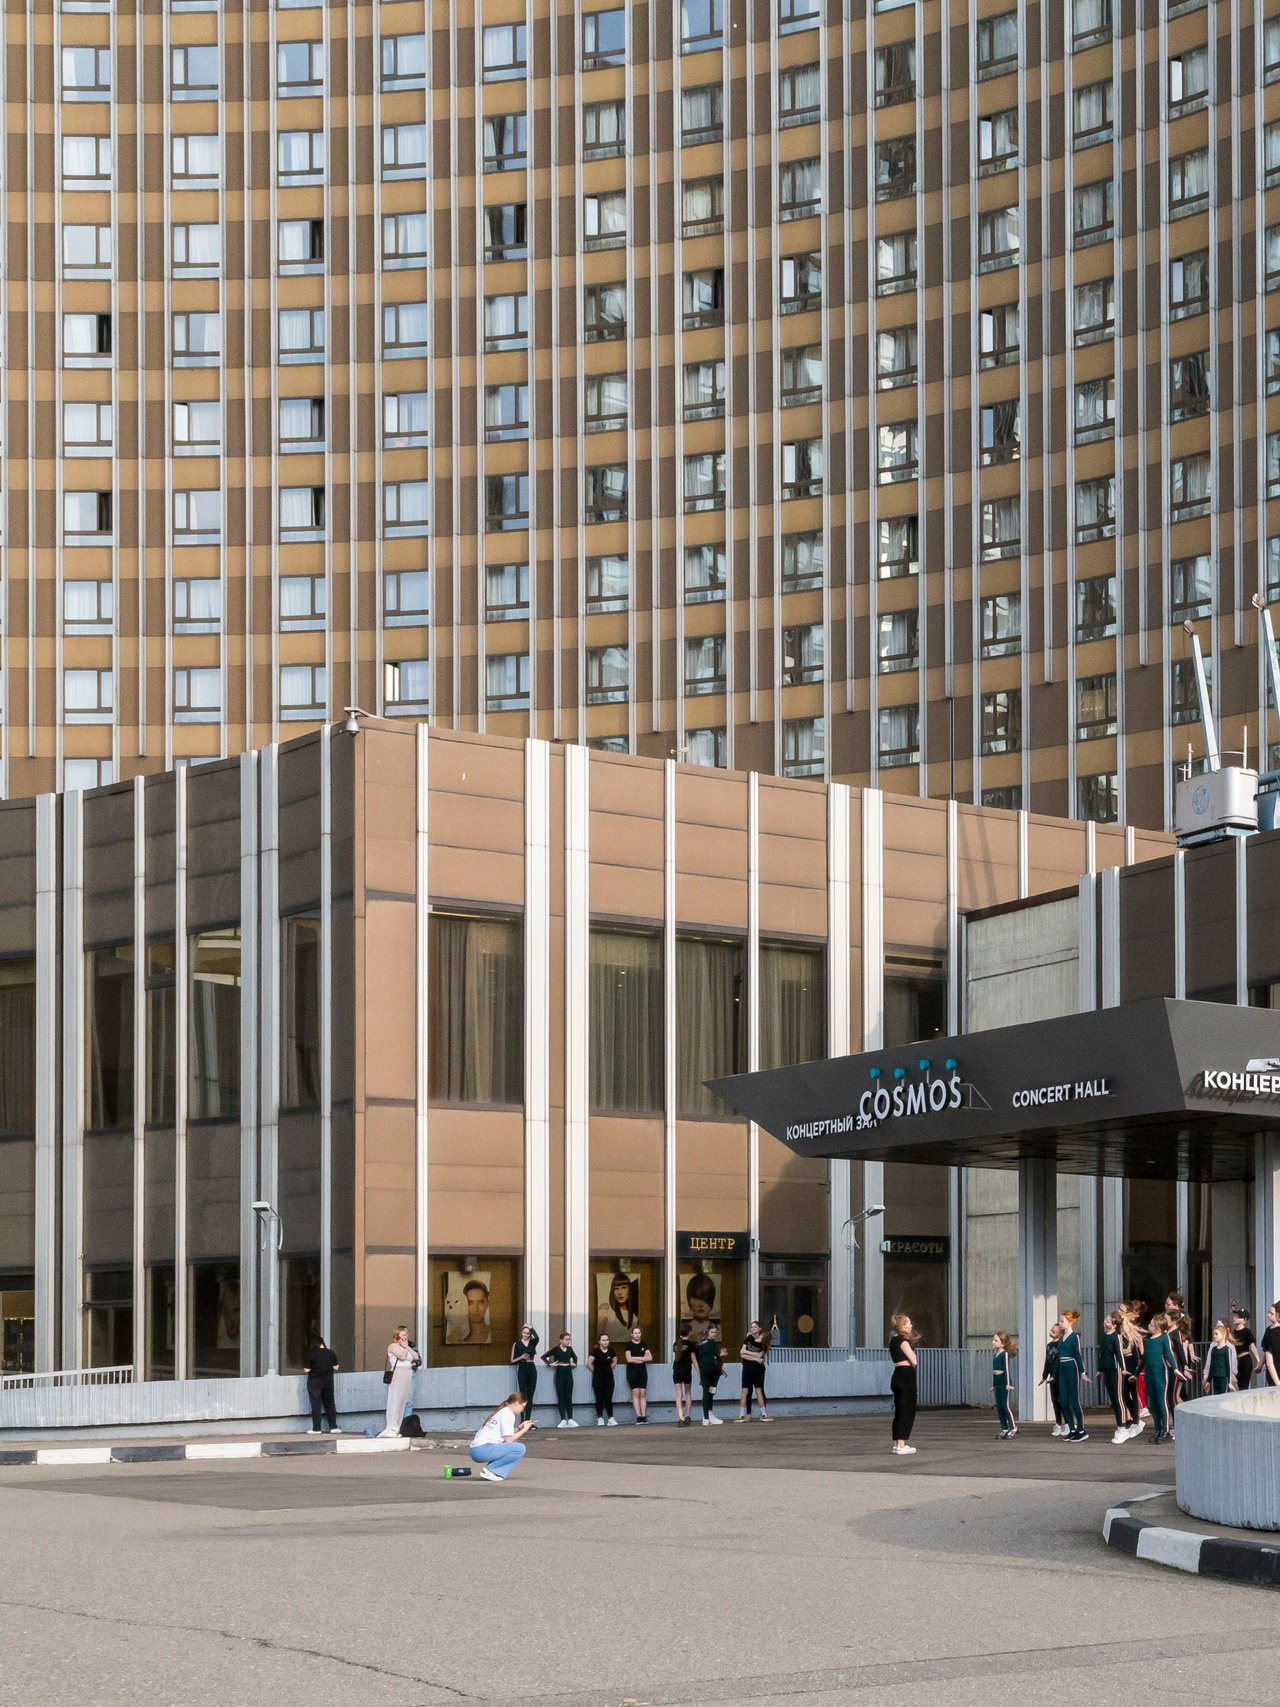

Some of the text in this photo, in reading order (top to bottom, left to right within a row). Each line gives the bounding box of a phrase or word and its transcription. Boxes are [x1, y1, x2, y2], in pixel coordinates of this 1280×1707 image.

[859, 1076, 962, 1121] COSMOS
[1012, 1078, 1109, 1108] CONCERT HALL
[786, 1115, 853, 1141] КОНЦЕРТНЫЙ
[689, 1237, 736, 1251] ЦЕНТР
